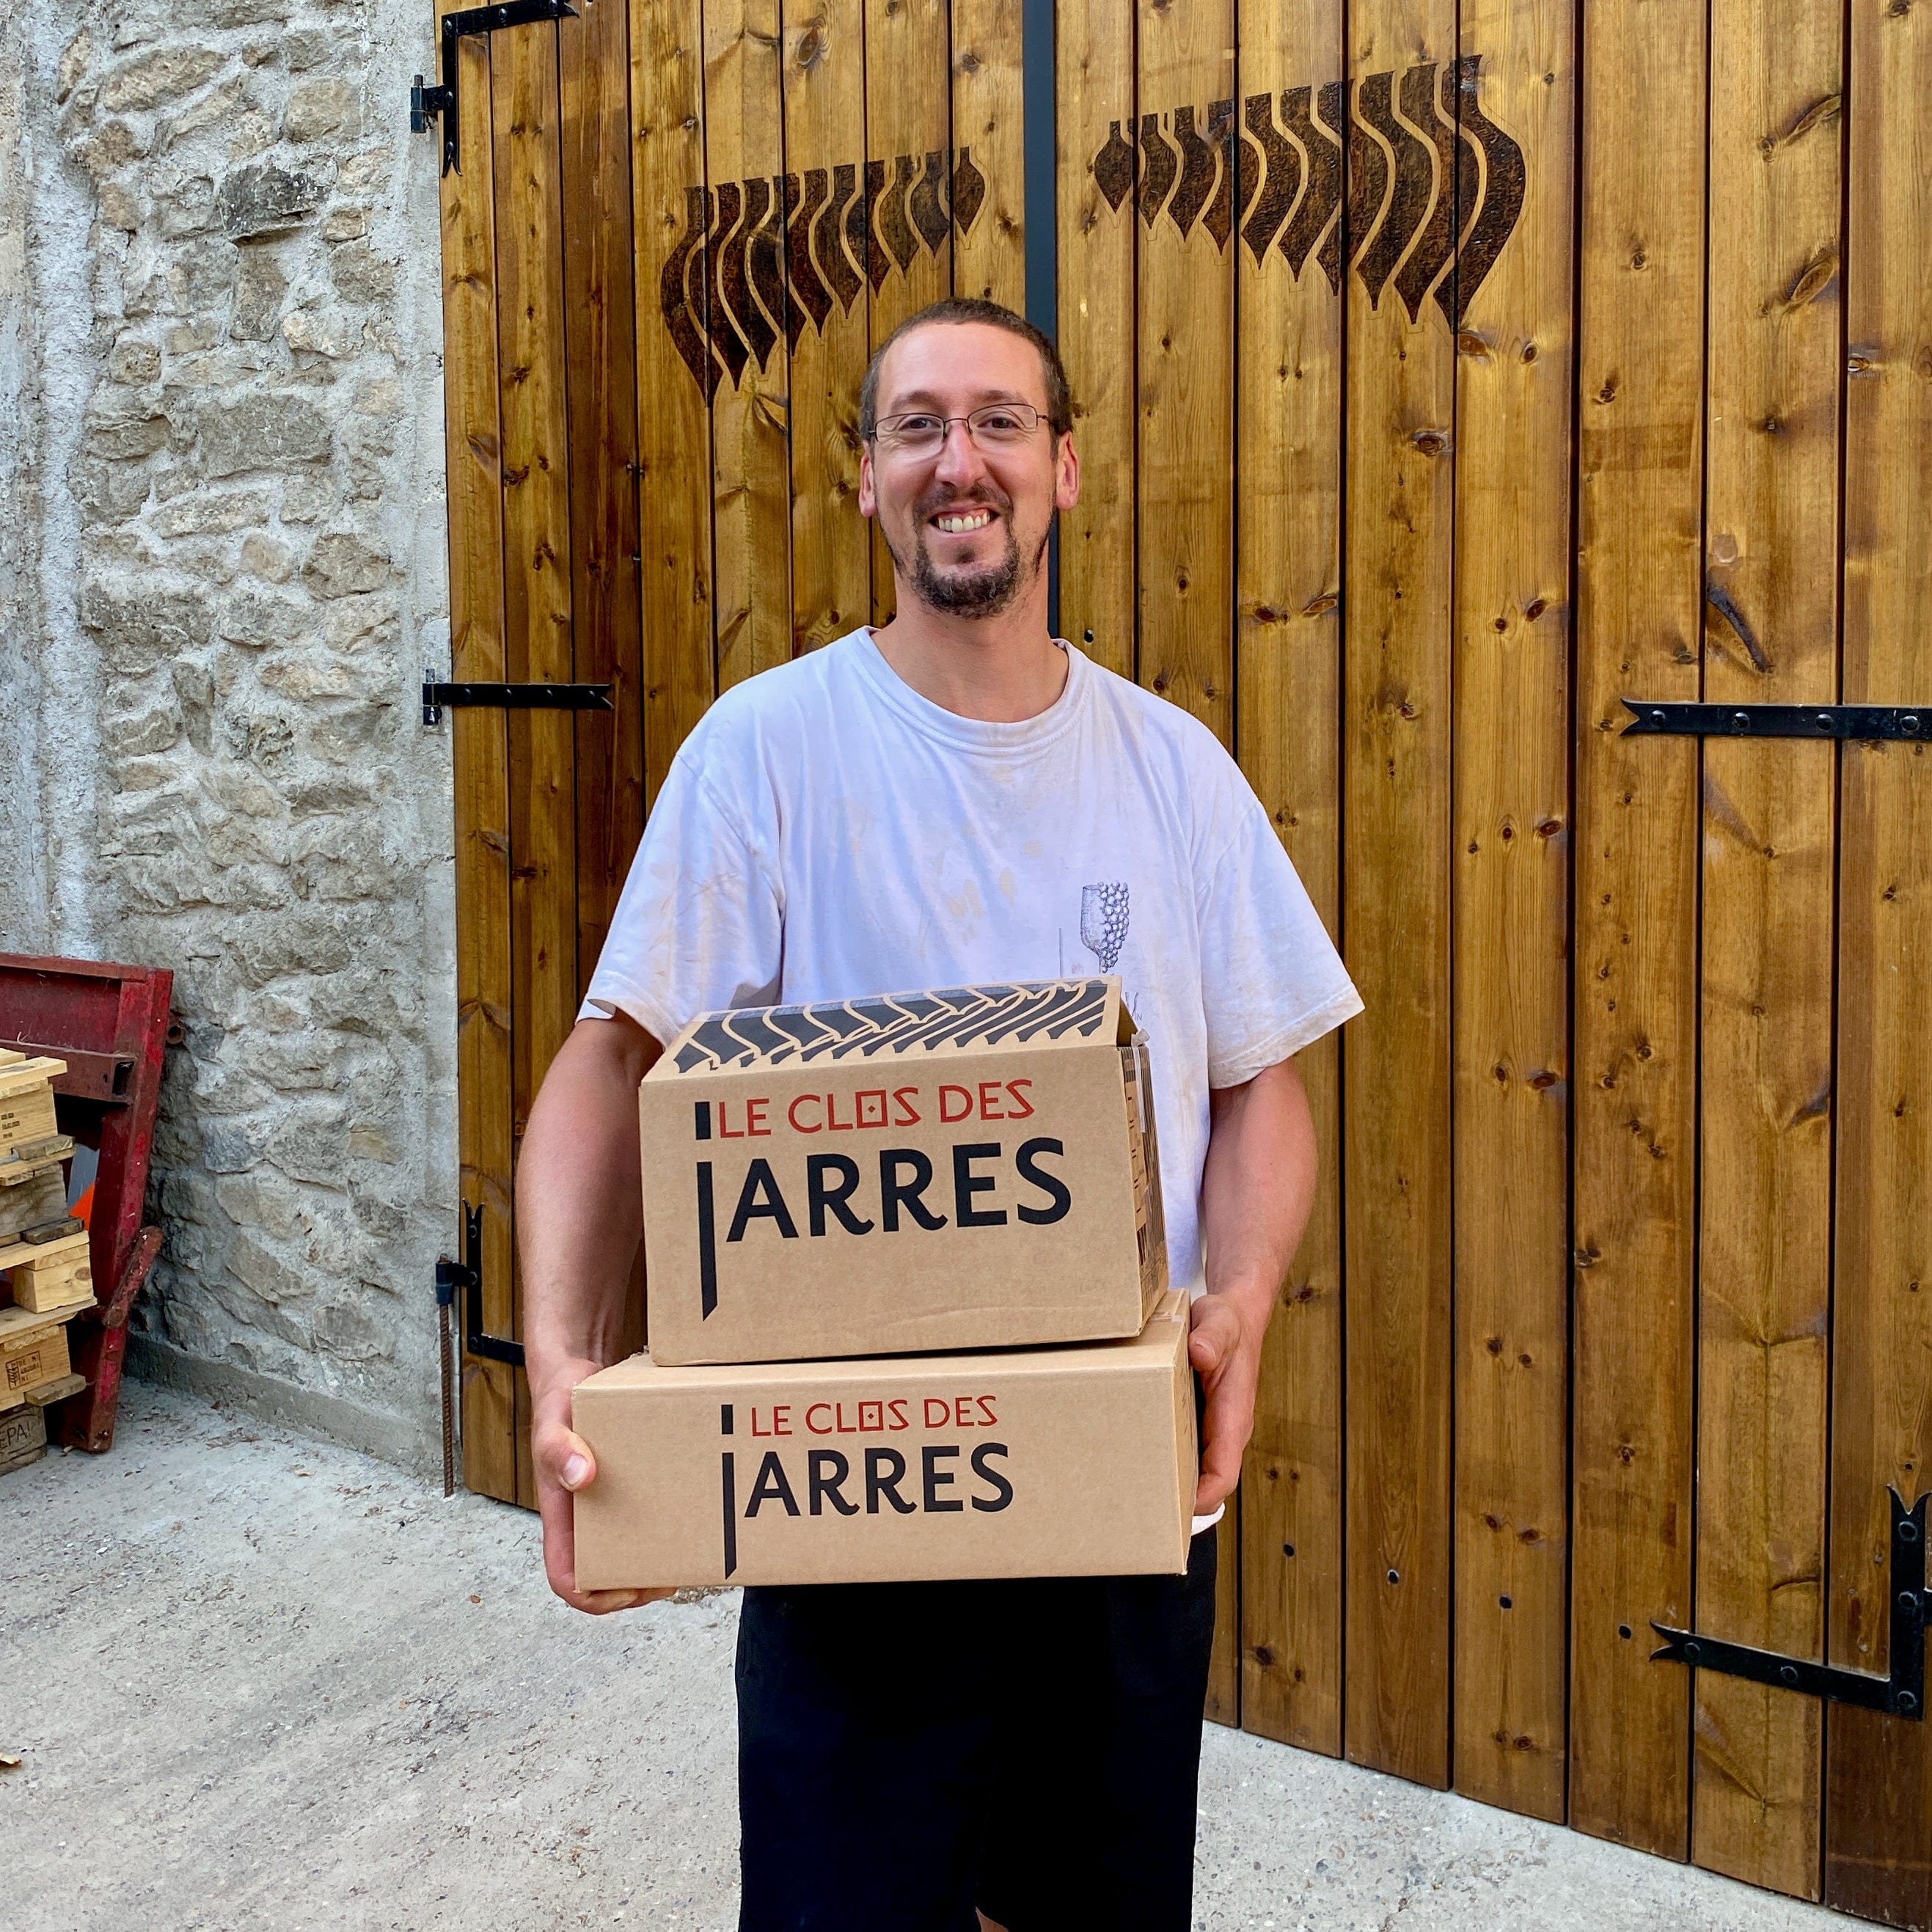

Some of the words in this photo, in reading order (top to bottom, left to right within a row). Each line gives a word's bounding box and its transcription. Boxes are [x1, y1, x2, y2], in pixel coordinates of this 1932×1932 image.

[718, 1098, 772, 1138] LE
[788, 1086, 921, 1134] CLOS
[938, 1078, 1035, 1124] DES
[751, 1406, 793, 1437] LE
[805, 1399, 909, 1435] CLOS
[923, 1395, 998, 1429] DES
